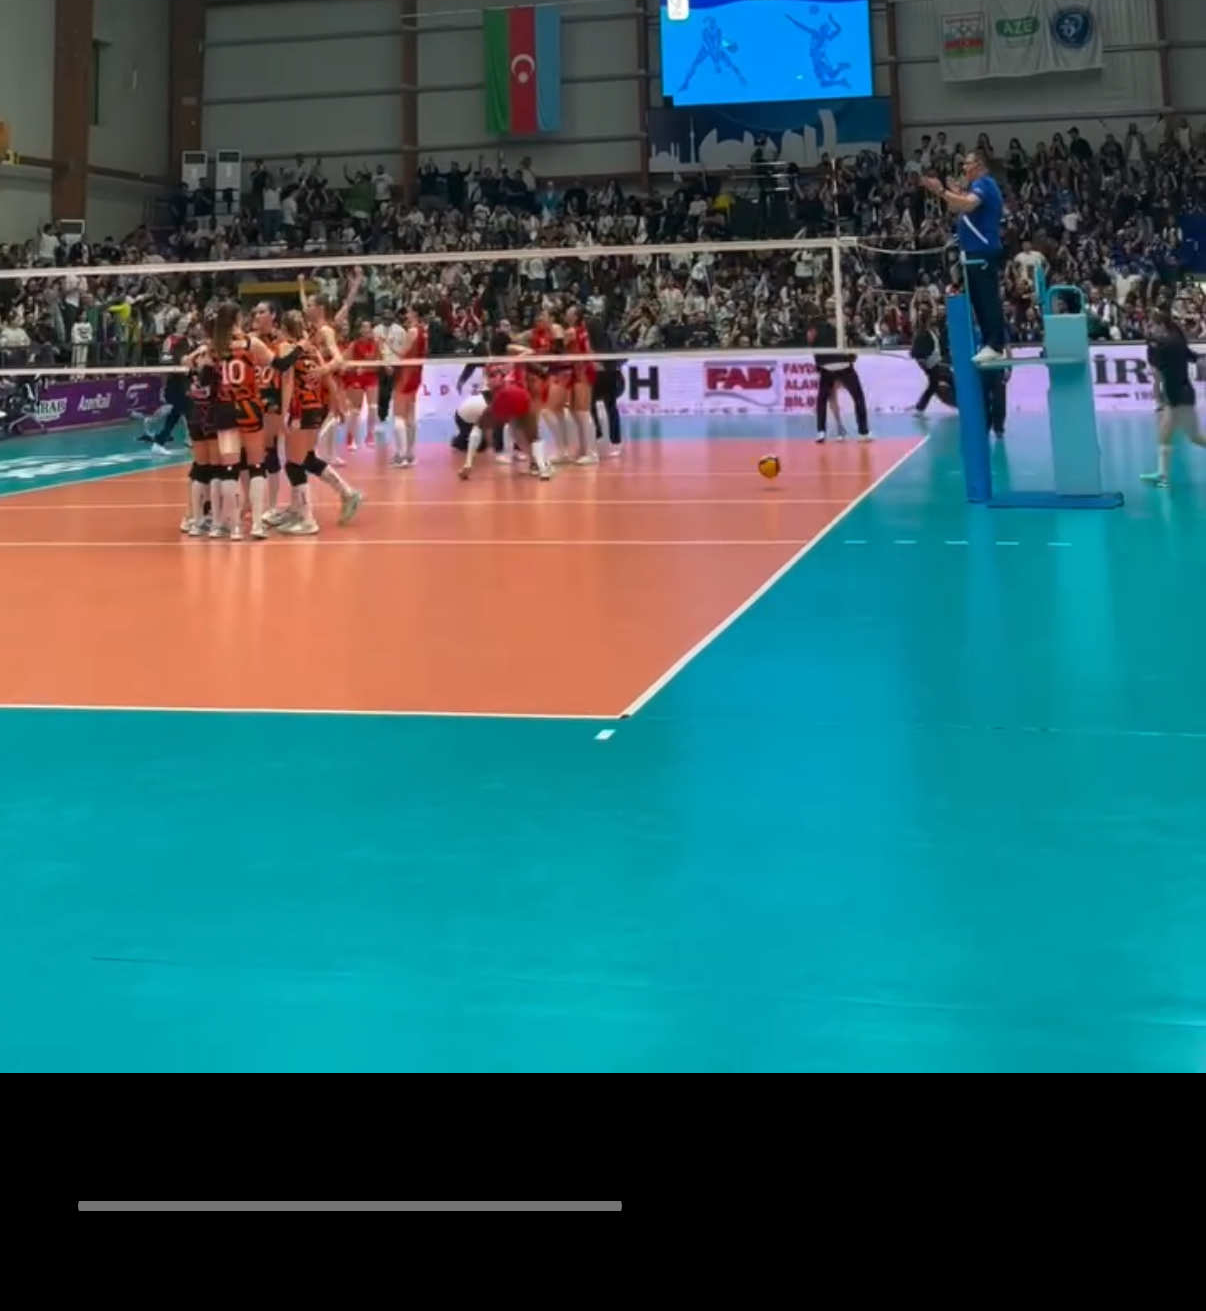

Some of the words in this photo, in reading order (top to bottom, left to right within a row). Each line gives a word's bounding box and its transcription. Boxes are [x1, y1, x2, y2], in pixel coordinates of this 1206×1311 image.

[1003, 20, 1033, 35] AZE
[221, 360, 245, 385] 10
[706, 368, 773, 389] FAB
